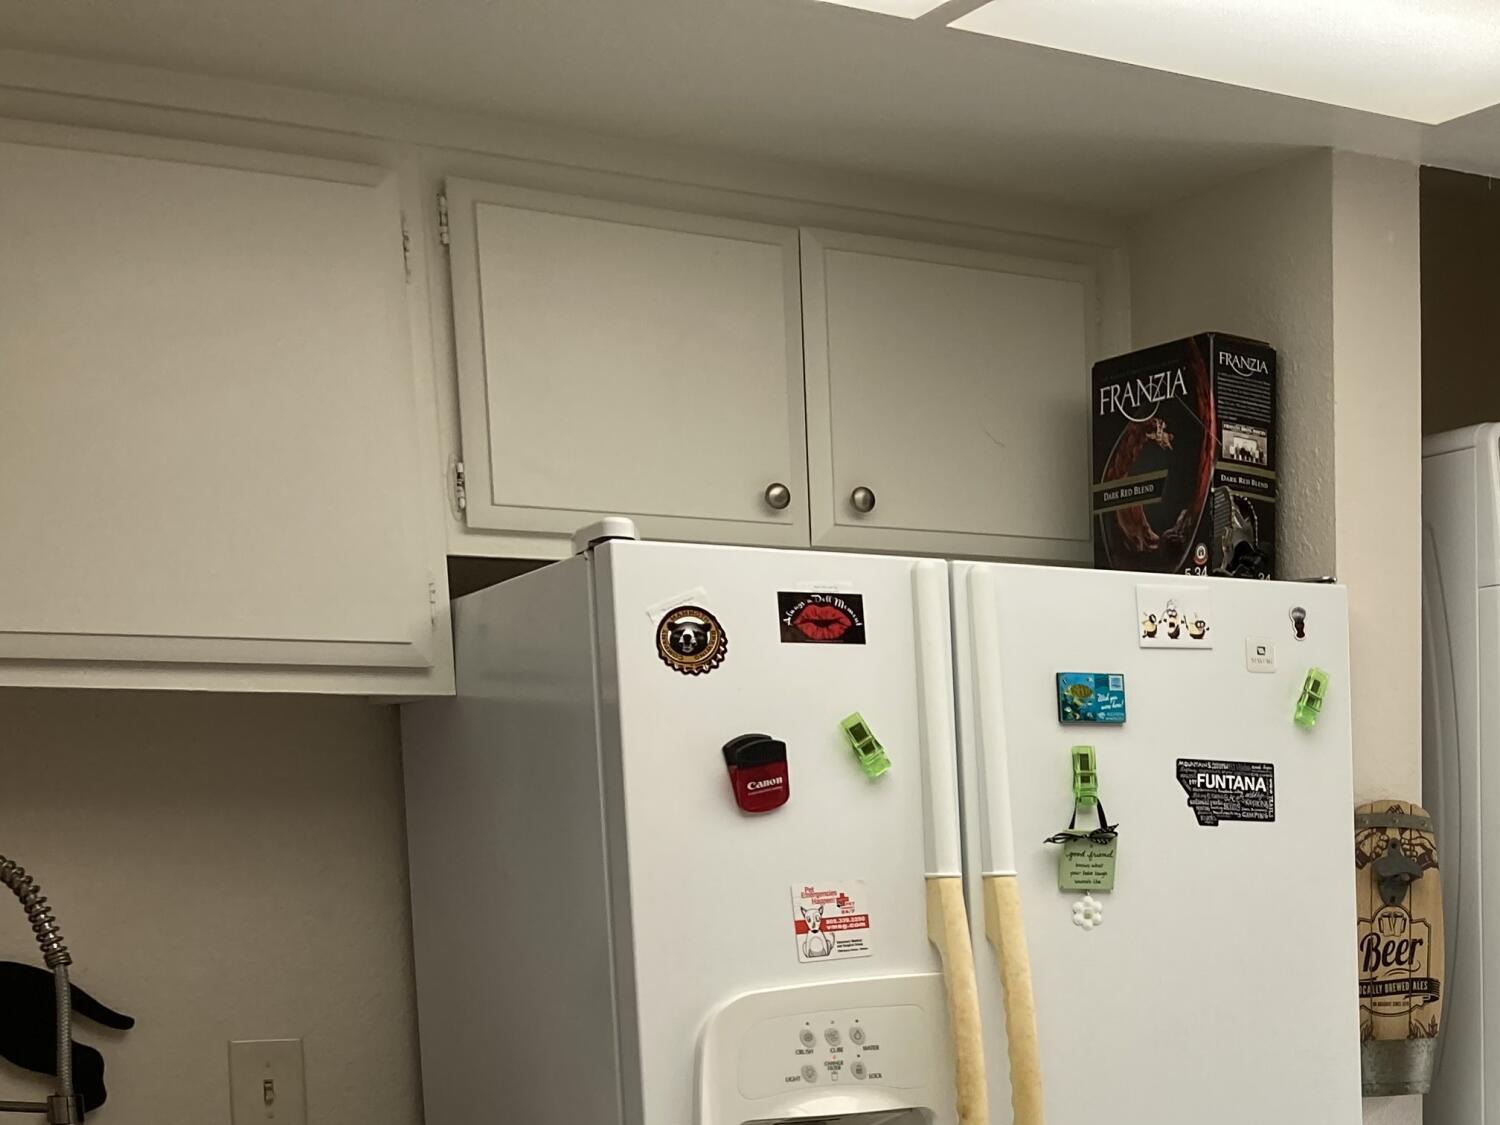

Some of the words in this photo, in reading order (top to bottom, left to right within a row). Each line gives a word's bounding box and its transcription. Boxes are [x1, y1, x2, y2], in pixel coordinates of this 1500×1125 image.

[1219, 351, 1269, 377] FRANZIA
[1100, 368, 1188, 422] FRANZIA
[1221, 473, 1237, 483] DARK
[1238, 476, 1251, 485] RED
[1251, 479, 1269, 489] BLEND
[1103, 491, 1120, 502] DARK
[1120, 488, 1133, 498] RED
[1133, 484, 1155, 496] BLEND
[747, 776, 783, 791] Canon
[1197, 773, 1267, 792] FUNTANA
[1360, 932, 1423, 973] Beer
[1360, 985, 1383, 996] OCALLY
[1384, 981, 1410, 994] BREWED
[1412, 980, 1429, 992] ALES
